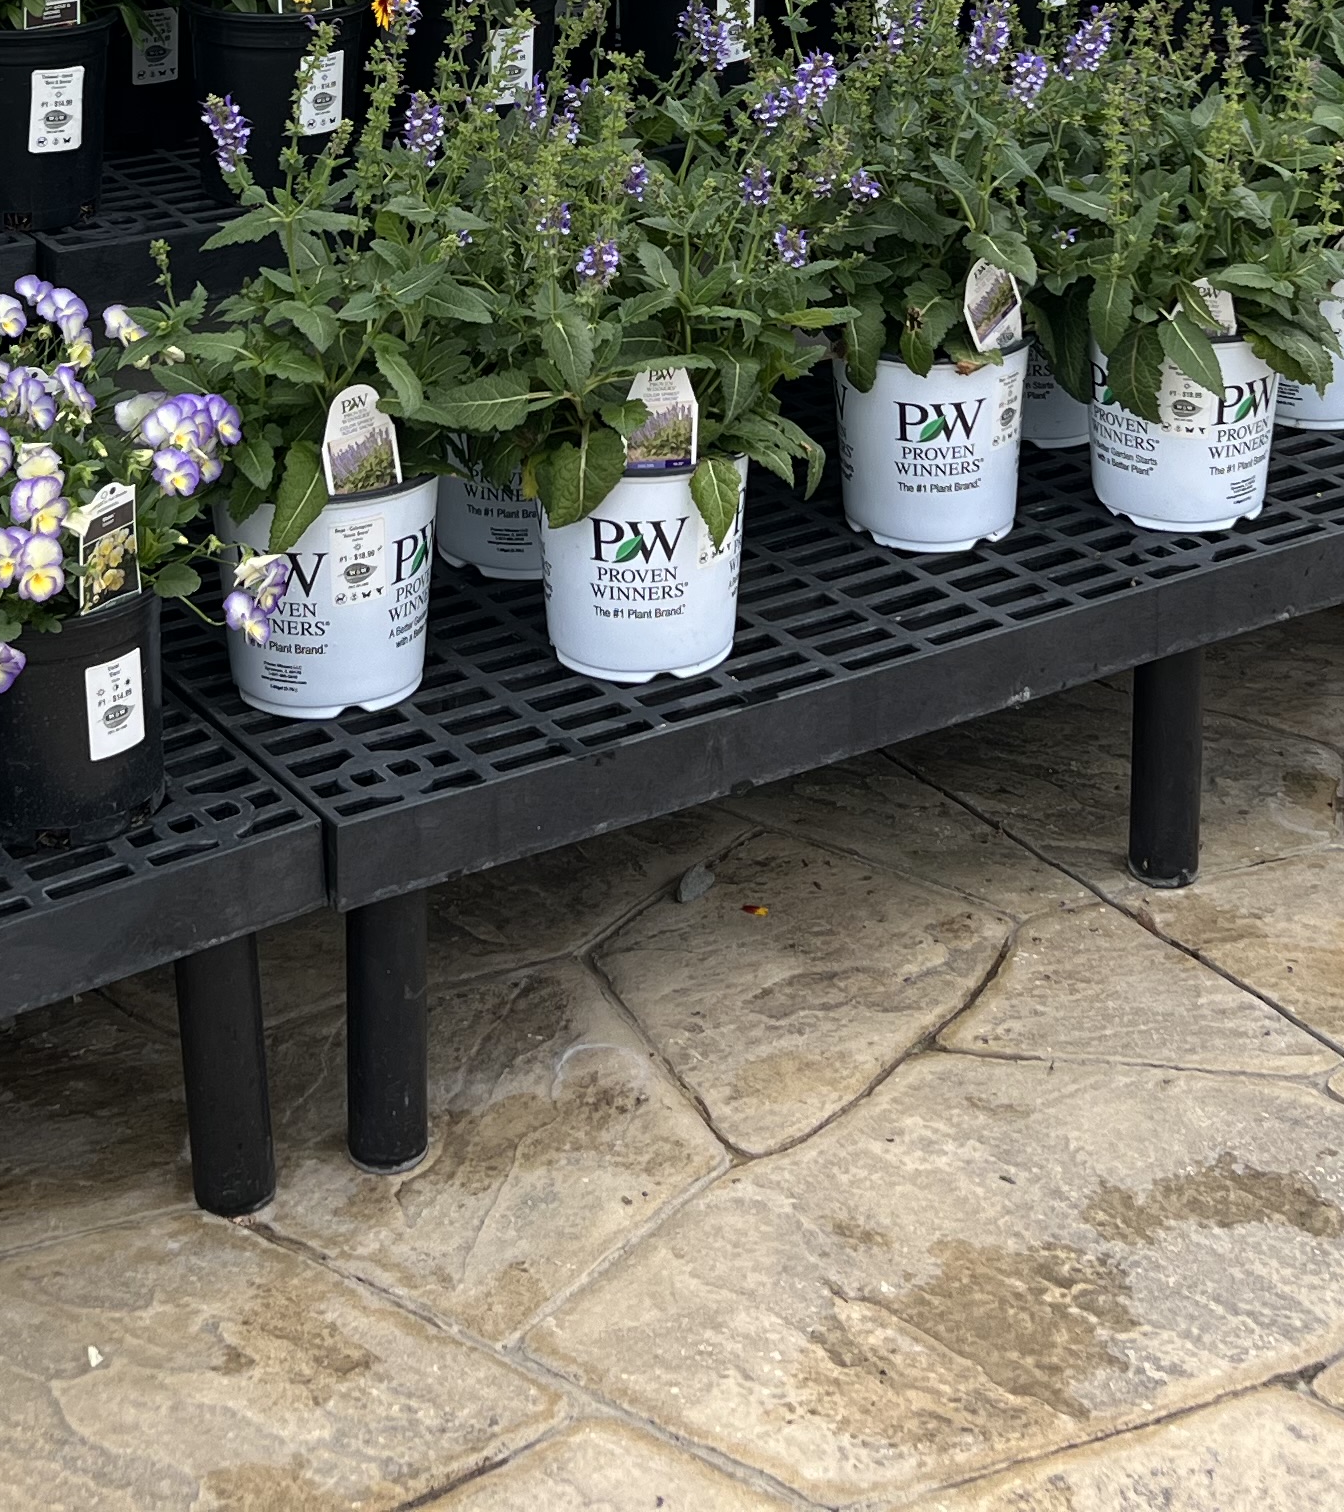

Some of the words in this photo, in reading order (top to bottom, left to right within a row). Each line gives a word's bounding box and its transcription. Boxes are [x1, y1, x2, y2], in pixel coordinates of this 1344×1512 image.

[341, 393, 368, 414] PW
[1212, 376, 1270, 426] PW
[893, 398, 987, 443] PW
[1094, 405, 1149, 434] PROVEN
[1217, 417, 1269, 443] PROVEN
[901, 444, 975, 461] PROVEN
[1209, 465, 1225, 476] The
[1227, 463, 1236, 472] #1
[898, 481, 914, 493] The
[917, 484, 927, 493] #1
[930, 484, 951, 493] Plant
[484, 508, 493, 517] #1
[497, 509, 519, 518] Plant
[588, 516, 689, 564] PW
[597, 566, 678, 583] PROVEN
[593, 605, 610, 618] The
[614, 608, 624, 618] #1
[628, 608, 652, 619] Plant
[269, 641, 293, 654] Plant
